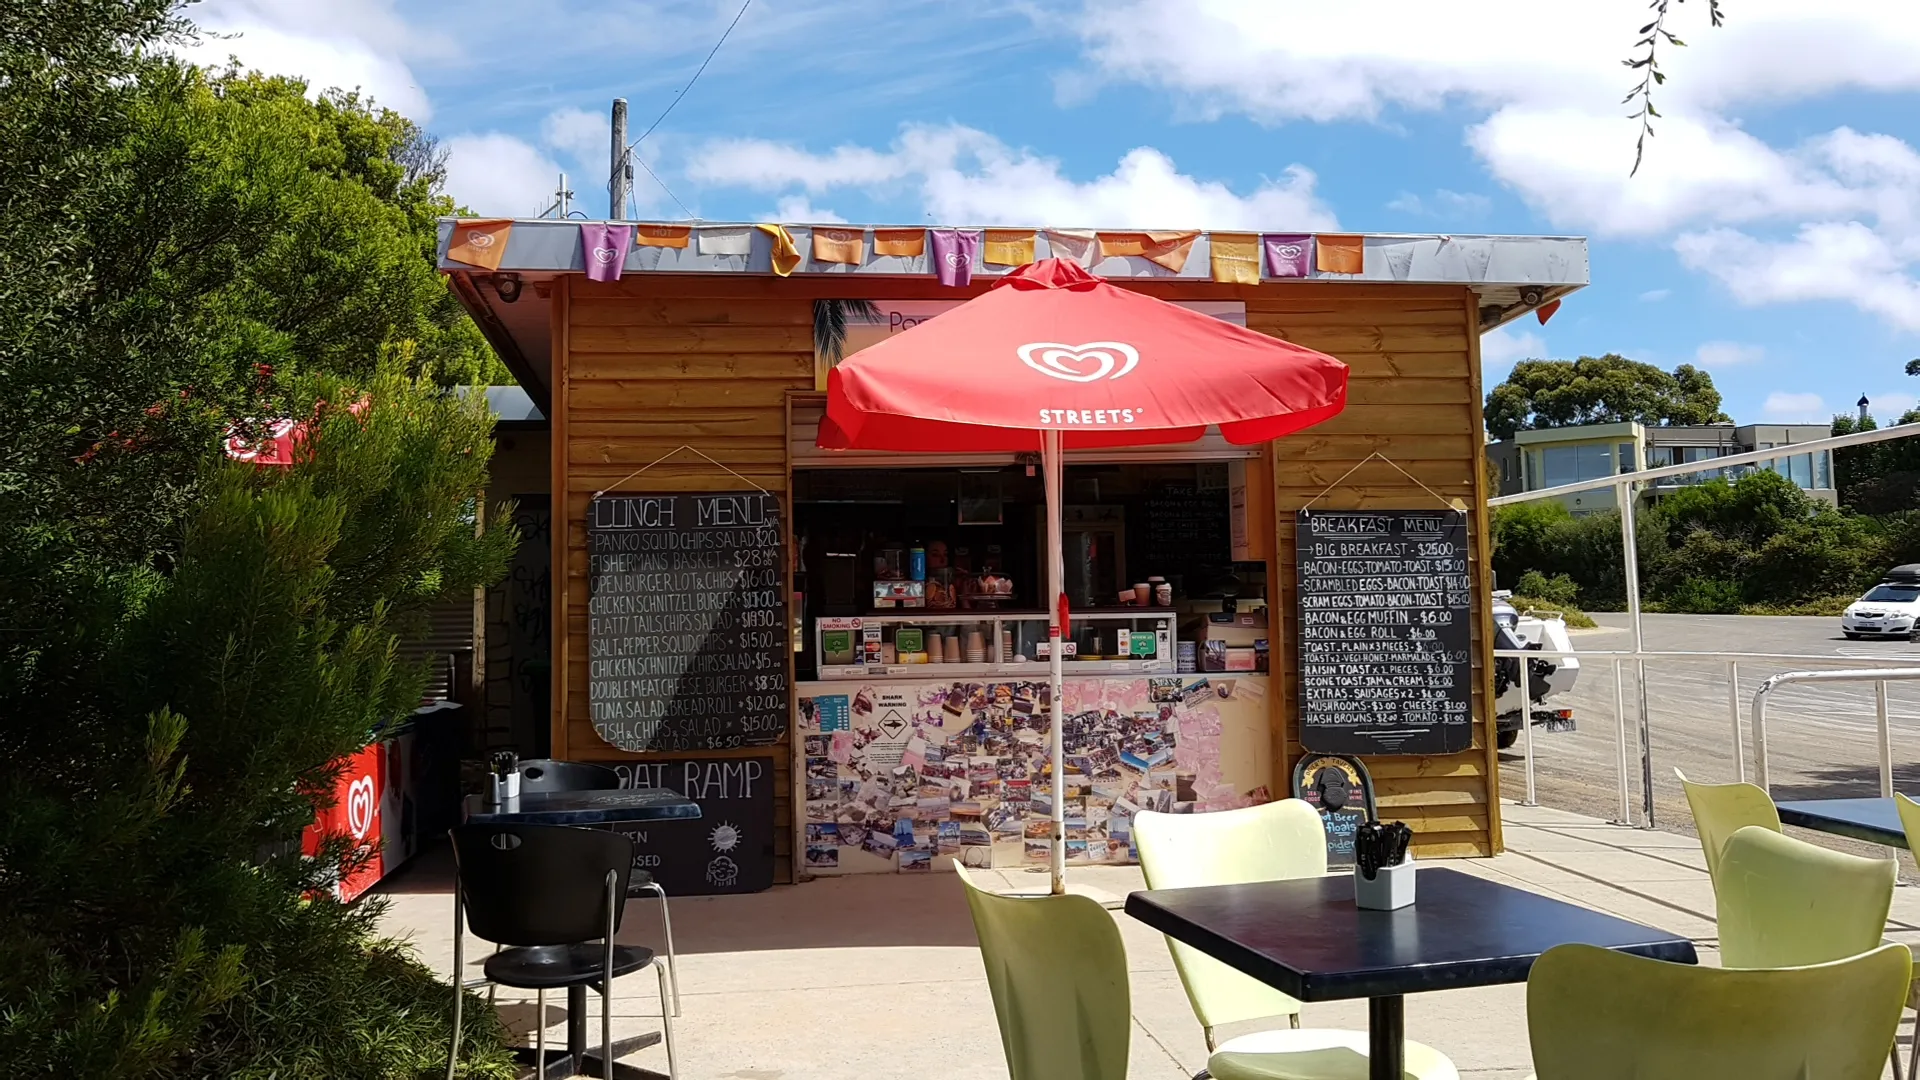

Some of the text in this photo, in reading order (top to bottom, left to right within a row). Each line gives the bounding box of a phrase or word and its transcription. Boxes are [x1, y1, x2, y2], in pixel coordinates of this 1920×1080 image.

[1112, 238, 1131, 246] HOT
[1039, 409, 1134, 424] STREETS
[595, 496, 765, 528] LUNCH MENU
[1311, 517, 1440, 533] BREAKFAST MENU
[595, 533, 639, 551] PANKO
[716, 531, 756, 548] SALAD
[1316, 543, 1336, 555] BIG
[1340, 542, 1408, 555] BREAKFAST
[591, 552, 668, 572] FISHERMANS
[674, 551, 722, 570] BASKET
[590, 575, 622, 593] OPEN
[674, 572, 698, 591] LOT
[697, 578, 705, 590] &
[705, 571, 734, 589] CHIPS
[1304, 579, 1358, 591] SCRAMBLED
[590, 591, 737, 615] CHICKEN SCHNITZEL BURGER
[1302, 596, 1330, 607] SCRAM
[591, 616, 630, 635] FLATTY
[694, 612, 733, 631] SALAD
[1305, 612, 1339, 625] BACON
[1340, 616, 1346, 624] &
[1347, 611, 1366, 624] EGG
[1368, 611, 1408, 624] MUFFIN
[1305, 627, 1338, 638] BACON
[1340, 630, 1346, 638] &
[1348, 627, 1366, 638] EGG
[1371, 626, 1397, 638] ROLL
[591, 639, 619, 657] SALT
[624, 636, 660, 655] PEPPER
[696, 632, 727, 652] CHIPS
[1304, 642, 1336, 652] TOAST
[1342, 642, 1368, 651] PLAIN
[1383, 642, 1409, 651] PIECES
[591, 658, 636, 678] CHICKEN
[637, 656, 692, 675] SCHNITZEL
[719, 652, 751, 672] SALAD
[1305, 666, 1336, 675] RAISIN
[1339, 665, 1371, 674] TOAST
[1390, 665, 1418, 674] PIECES
[591, 679, 630, 699] DOUBLE
[661, 676, 703, 697] CHEESE
[706, 675, 747, 694] BURGER
[1305, 677, 1334, 686] SCONE
[1393, 676, 1424, 685] CREAM
[1306, 688, 1348, 699] EXTRAS
[1354, 688, 1399, 699] SAUSAGES
[592, 702, 624, 720] TUNA
[626, 700, 665, 718] SALAD
[670, 698, 706, 716] BREAD
[708, 696, 735, 714] ROLL
[1307, 701, 1366, 711] MUSHROOMS
[1402, 701, 1438, 710] CHEESE
[1307, 714, 1332, 724] HASH
[1334, 713, 1372, 723] BROWNS
[1402, 712, 1437, 722] TOMATO
[596, 722, 625, 740] FISH
[626, 730, 633, 739] &
[634, 720, 671, 739] CHIPS
[680, 717, 721, 737] SALAD
[648, 738, 689, 751] SALAD
[684, 761, 762, 799] RAMP
[1335, 813, 1358, 821] Beer
